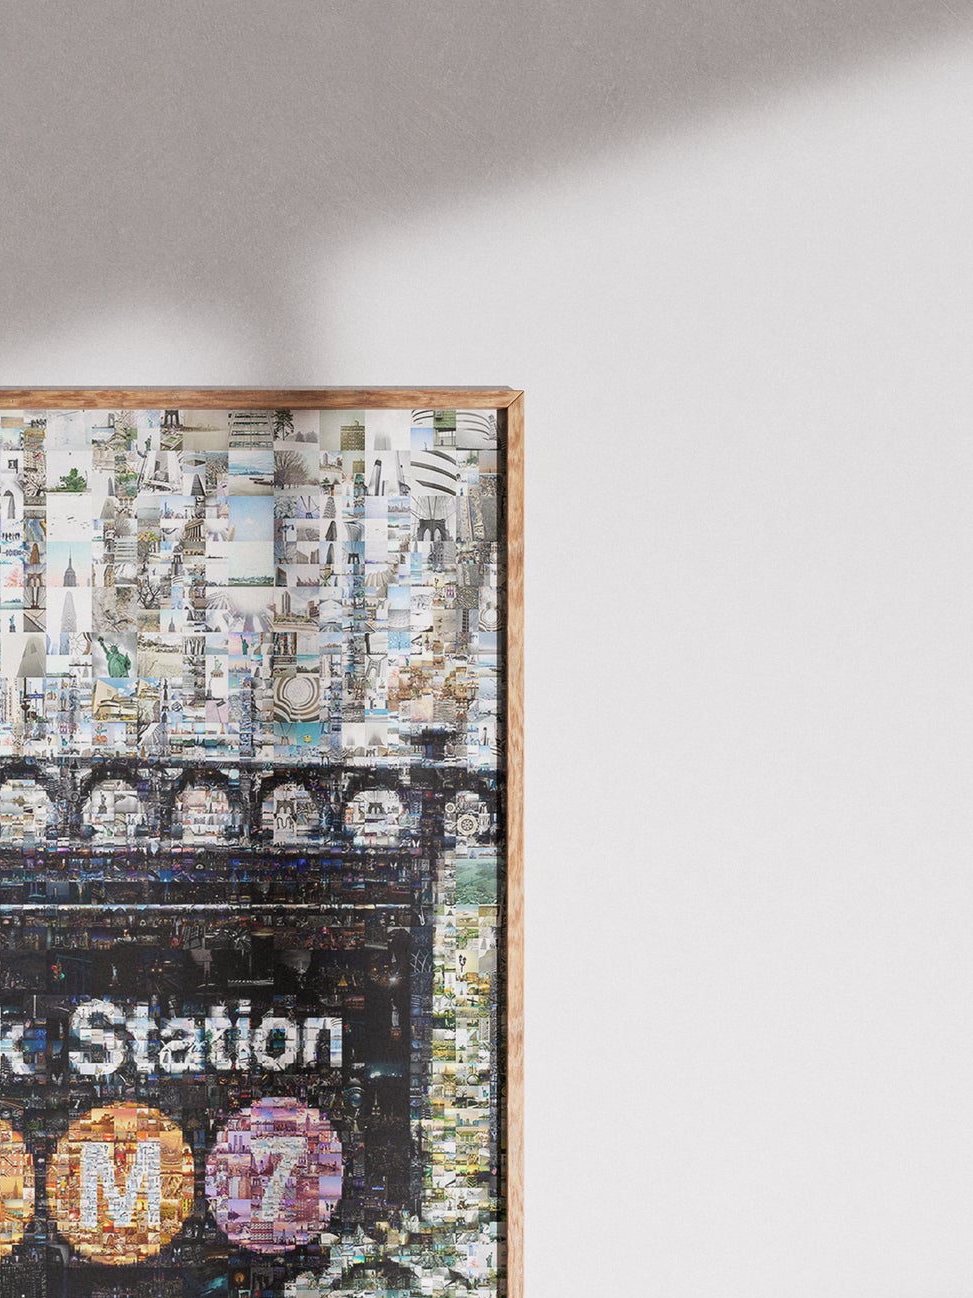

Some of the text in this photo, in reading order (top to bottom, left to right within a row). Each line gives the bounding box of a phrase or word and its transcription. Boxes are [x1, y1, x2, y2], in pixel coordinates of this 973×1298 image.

[68, 997, 344, 1076] Station
[80, 1140, 161, 1228] M
[250, 1136, 309, 1224] 7
